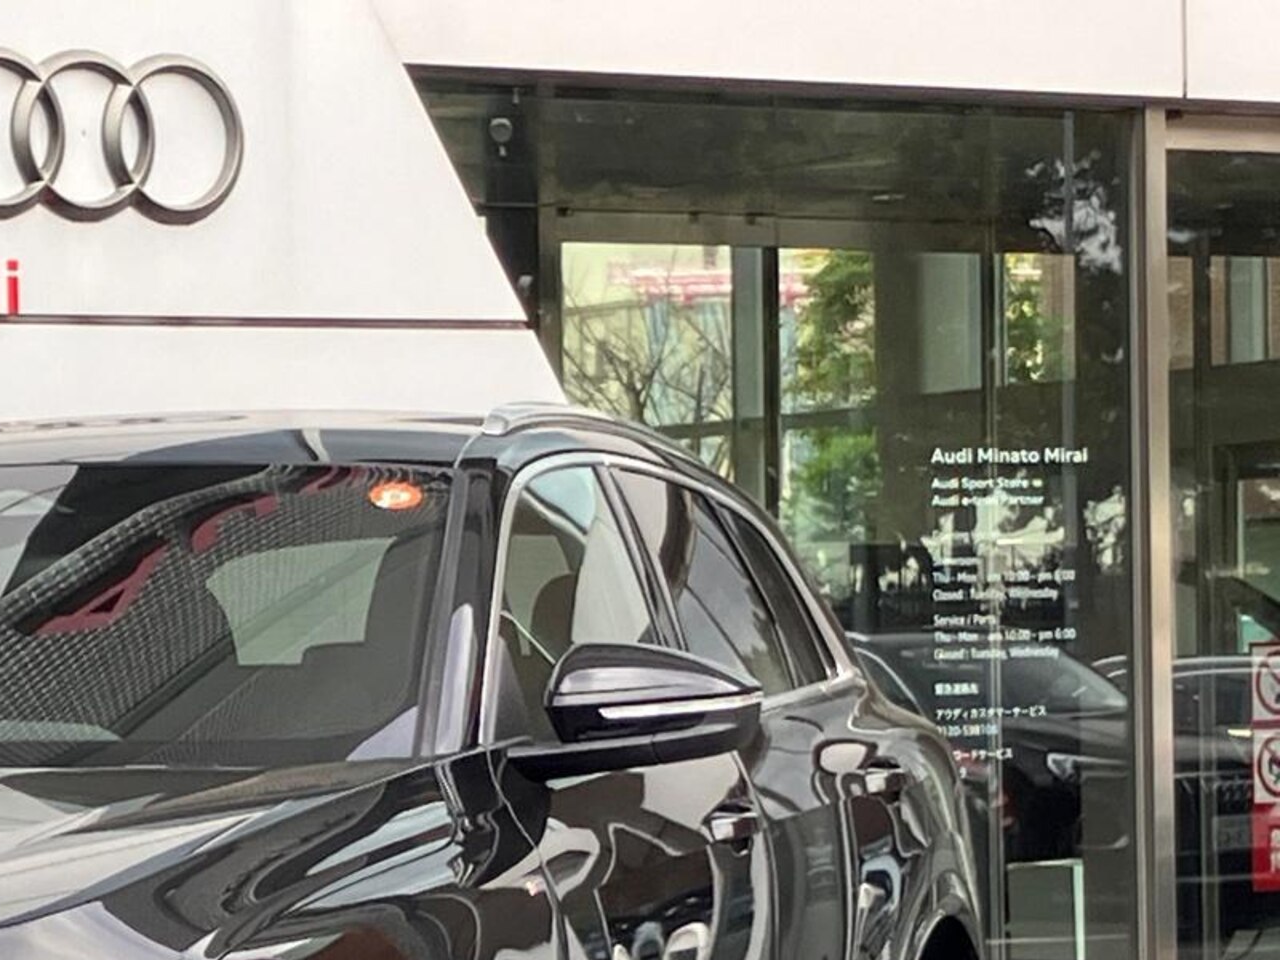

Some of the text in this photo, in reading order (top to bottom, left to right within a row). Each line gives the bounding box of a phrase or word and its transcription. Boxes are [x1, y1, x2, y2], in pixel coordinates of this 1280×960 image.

[931, 447, 1089, 464] Audi Minato Mirai
[932, 477, 959, 489] Audi
[961, 476, 995, 491] Sport
[932, 494, 959, 506] Audi
[934, 614, 965, 626] Service
